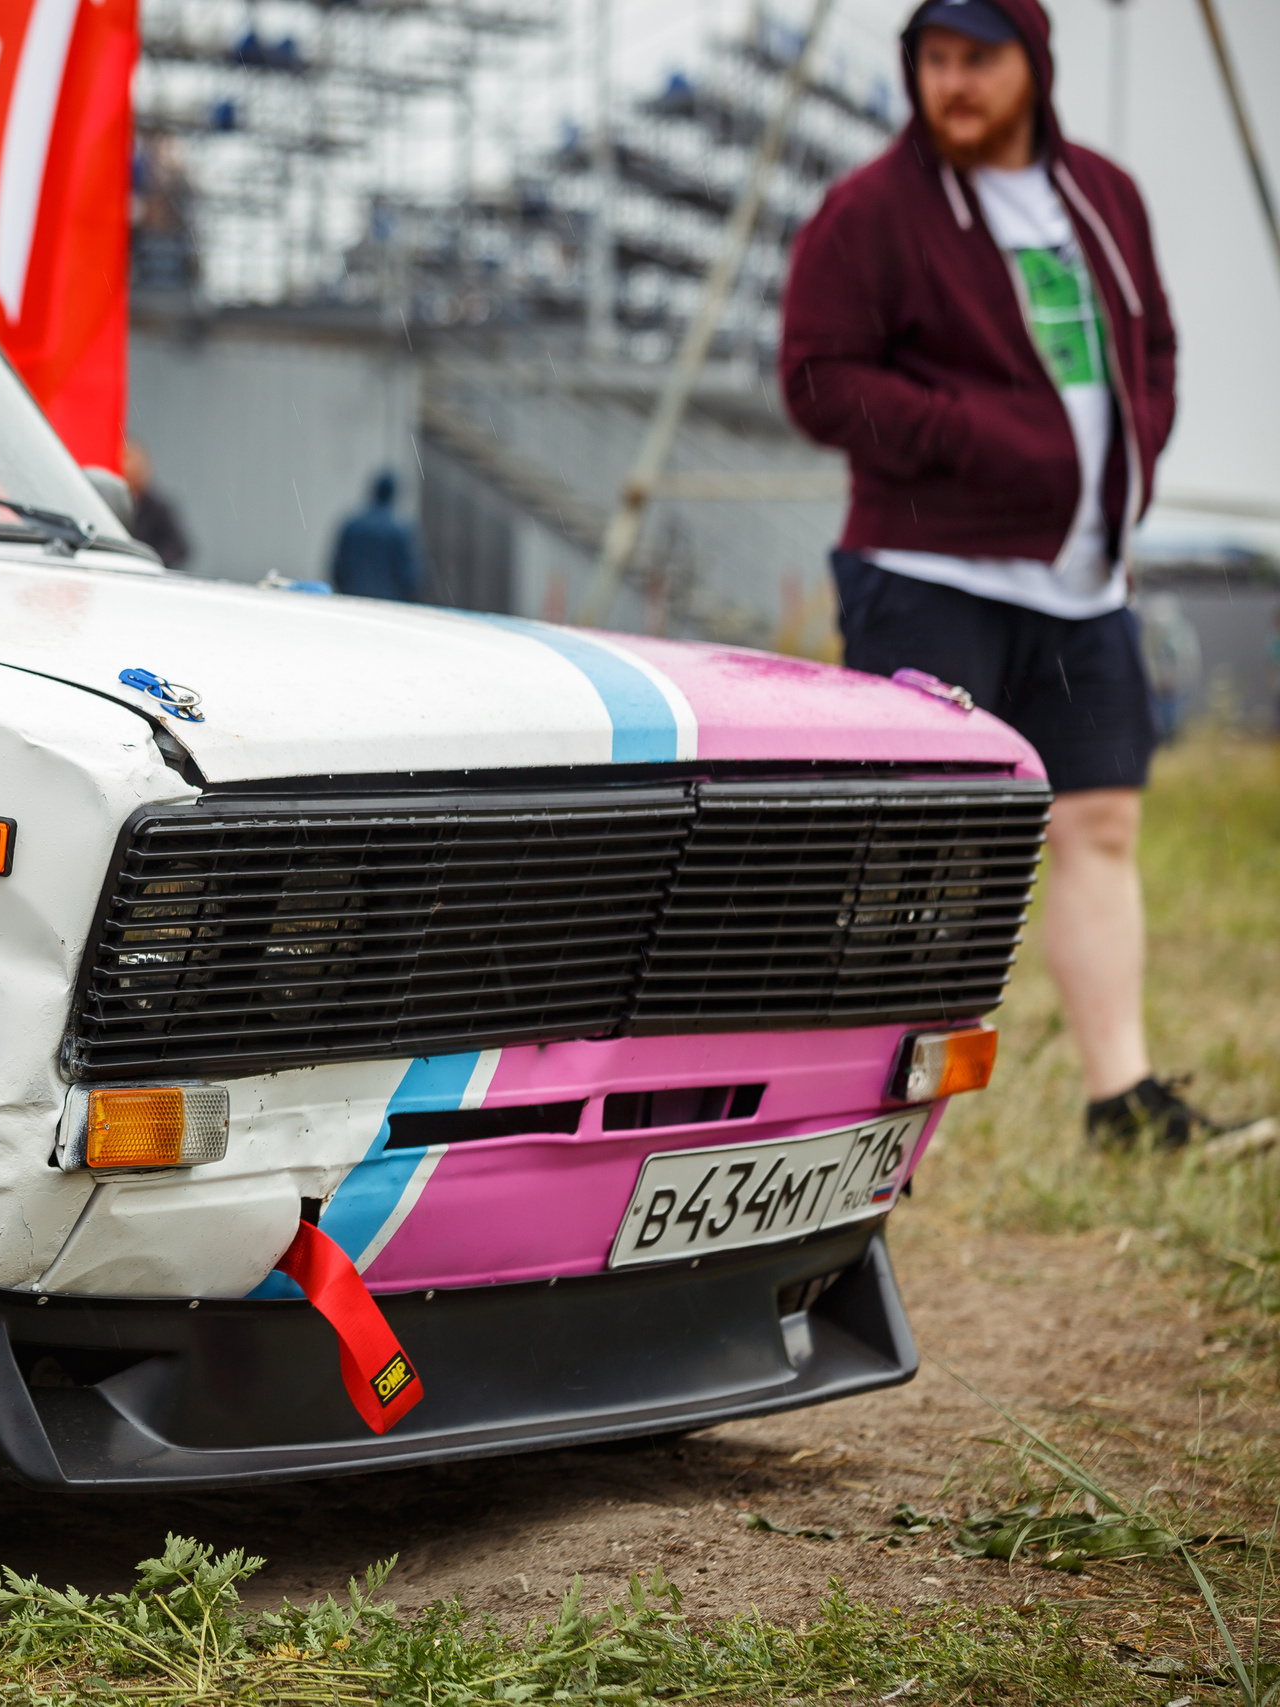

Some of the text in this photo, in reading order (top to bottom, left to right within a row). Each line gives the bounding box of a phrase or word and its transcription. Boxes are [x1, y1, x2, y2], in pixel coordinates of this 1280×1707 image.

[840, 1121, 911, 1193] 716
[842, 1187, 873, 1213] RUS
[377, 1361, 407, 1397] OMP
